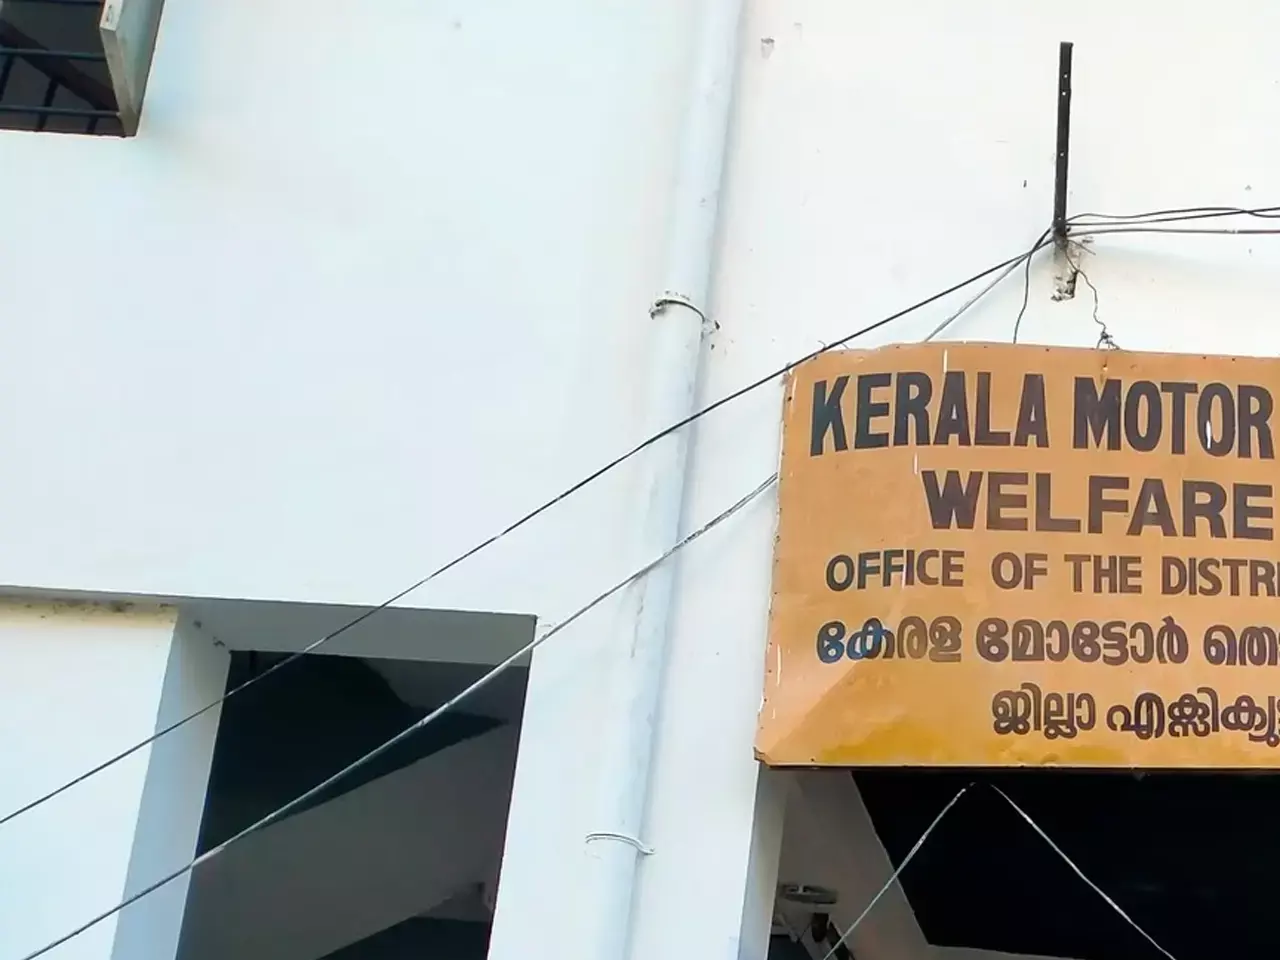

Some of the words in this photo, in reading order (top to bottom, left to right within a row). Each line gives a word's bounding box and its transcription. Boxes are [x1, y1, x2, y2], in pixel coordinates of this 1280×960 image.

[810, 371, 1049, 457] KERALA
[1073, 377, 1274, 459] MOTOR
[921, 470, 1273, 541] WELFARE
[826, 549, 964, 591] OFFICE
[992, 552, 1047, 590] OF
[1064, 554, 1142, 594] THE
[816, 616, 962, 664] കേരള
[976, 616, 1188, 666] മോട്ടോർ
[992, 683, 1096, 740] ജില്ലാ
